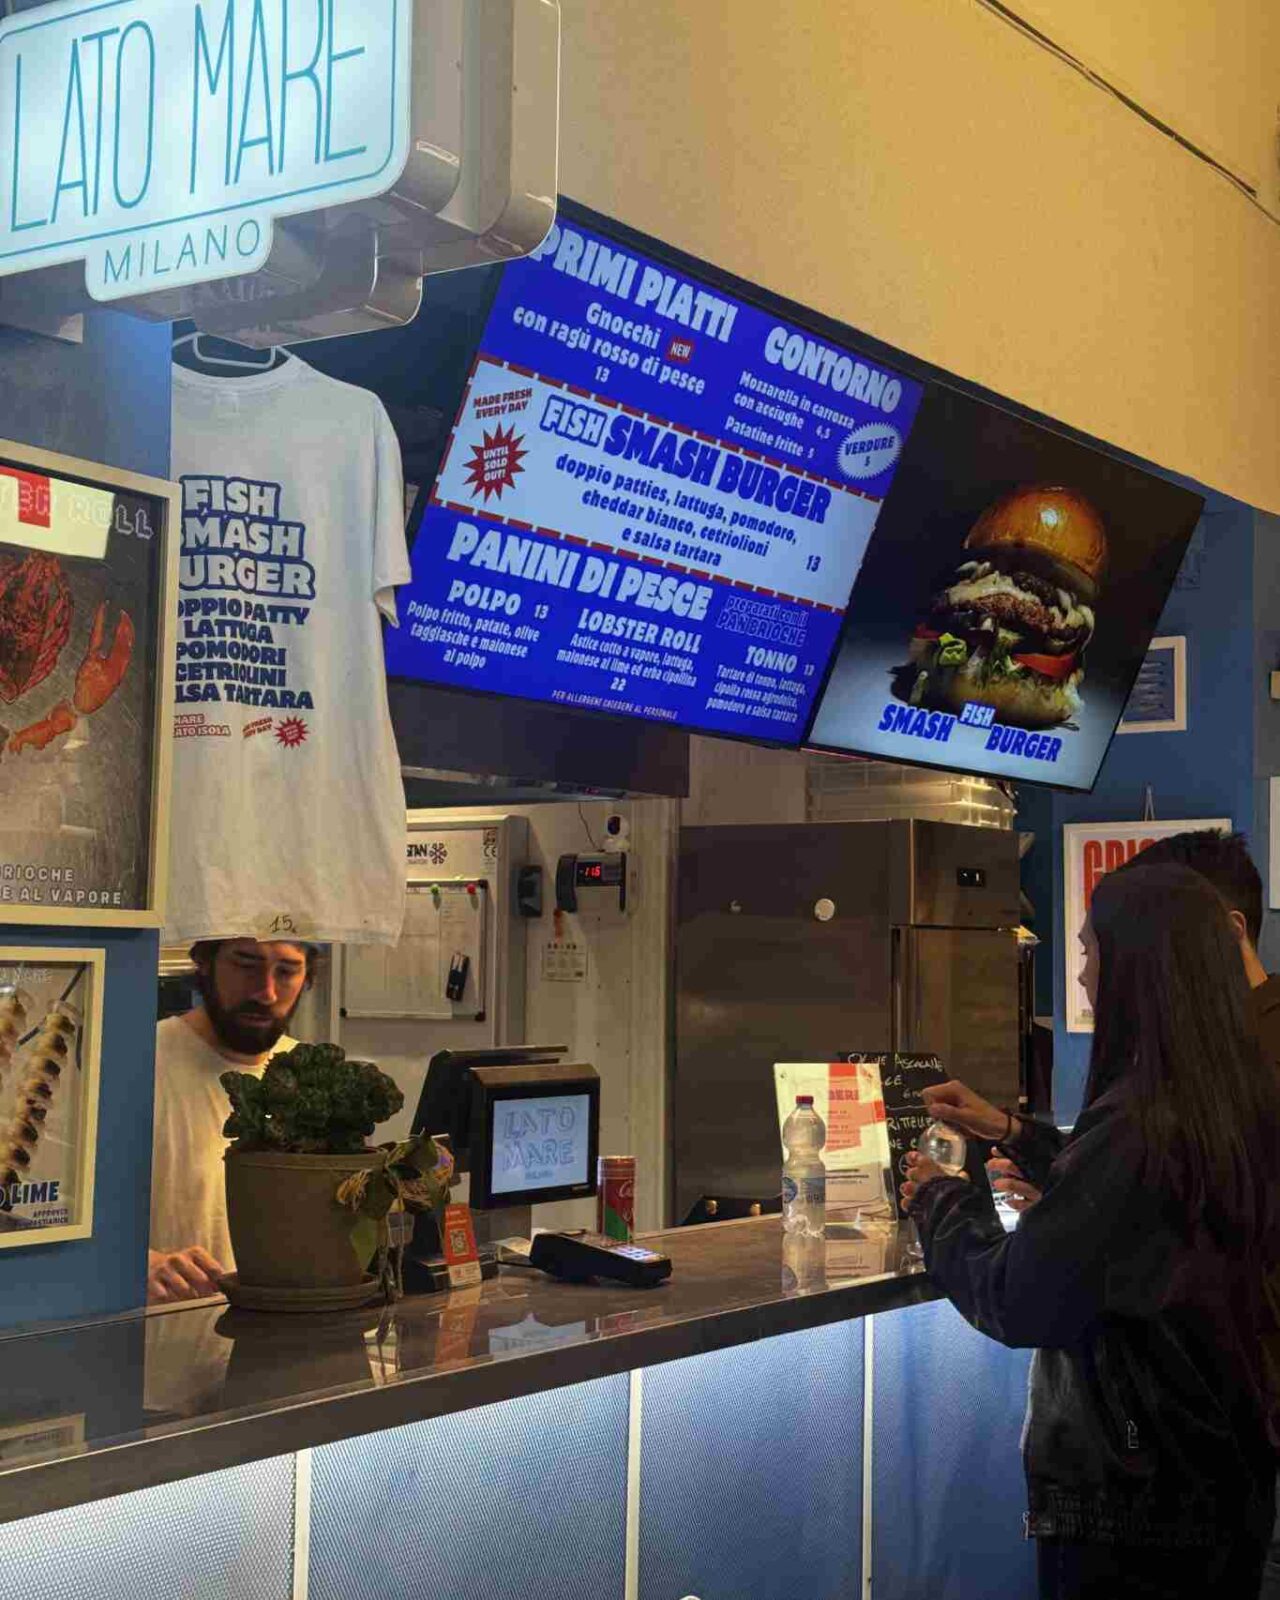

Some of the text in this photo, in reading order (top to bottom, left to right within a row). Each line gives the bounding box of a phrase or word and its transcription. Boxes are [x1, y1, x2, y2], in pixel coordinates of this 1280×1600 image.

[11, 0, 367, 232] LATO MARE
[103, 219, 261, 284] MILANO
[635, 266, 738, 342] PIATTI
[587, 303, 661, 349] Gnocchi
[513, 307, 705, 395] con ragù rosso di pesce
[671, 341, 691, 358] NEW
[595, 366, 611, 382] 13
[764, 326, 902, 413] CONTORNO
[473, 388, 533, 408] MADE FRESH
[475, 401, 530, 419] EVERY DAY
[733, 393, 756, 409] con
[759, 401, 804, 429] acciughe
[739, 370, 856, 429] Mozzarella in carrozza
[483, 445, 508, 459] UNTIL
[725, 415, 775, 446] Patatine
[773, 434, 804, 457] fritte
[845, 435, 896, 456] VERDURE
[483, 456, 507, 471] SOLD
[540, 394, 833, 524] FISH SMASH BURGER
[179, 474, 282, 520] FISH
[556, 453, 797, 545] doppio patties, lattuga, pomodoro,
[581, 489, 770, 557] cheddar bianco, cetriolioni
[621, 528, 722, 567] e salsa tartara
[805, 554, 822, 572] 13
[446, 521, 713, 621] PANINI DI PESCE
[243, 600, 311, 625] PATTY
[447, 579, 549, 619] POLPO 13
[407, 600, 541, 642] Polpo fritto, patate, olive
[578, 608, 702, 655] LOBSTER ROLL
[176, 640, 287, 667] POMODORI
[410, 622, 528, 658] taggiasche e maionese
[570, 633, 600, 650] Astice
[599, 641, 622, 656] cotto
[443, 649, 487, 670] al polpo
[556, 649, 600, 668] maionese
[599, 658, 609, 671] al
[610, 660, 630, 674] lime
[744, 645, 798, 673] TONNO
[223, 683, 315, 710] TARTARA
[610, 677, 627, 691] 22
[877, 702, 958, 743] SMASH
[959, 702, 996, 729] FISH
[984, 723, 1062, 762] BURGER
[0, 864, 74, 882] RIOCHE
[20, 887, 42, 901] AL
[51, 888, 122, 905] VAPORE
[503, 1105, 576, 1140] LATO
[502, 1138, 578, 1172] MARE
[11, 1180, 60, 1205] LIME
